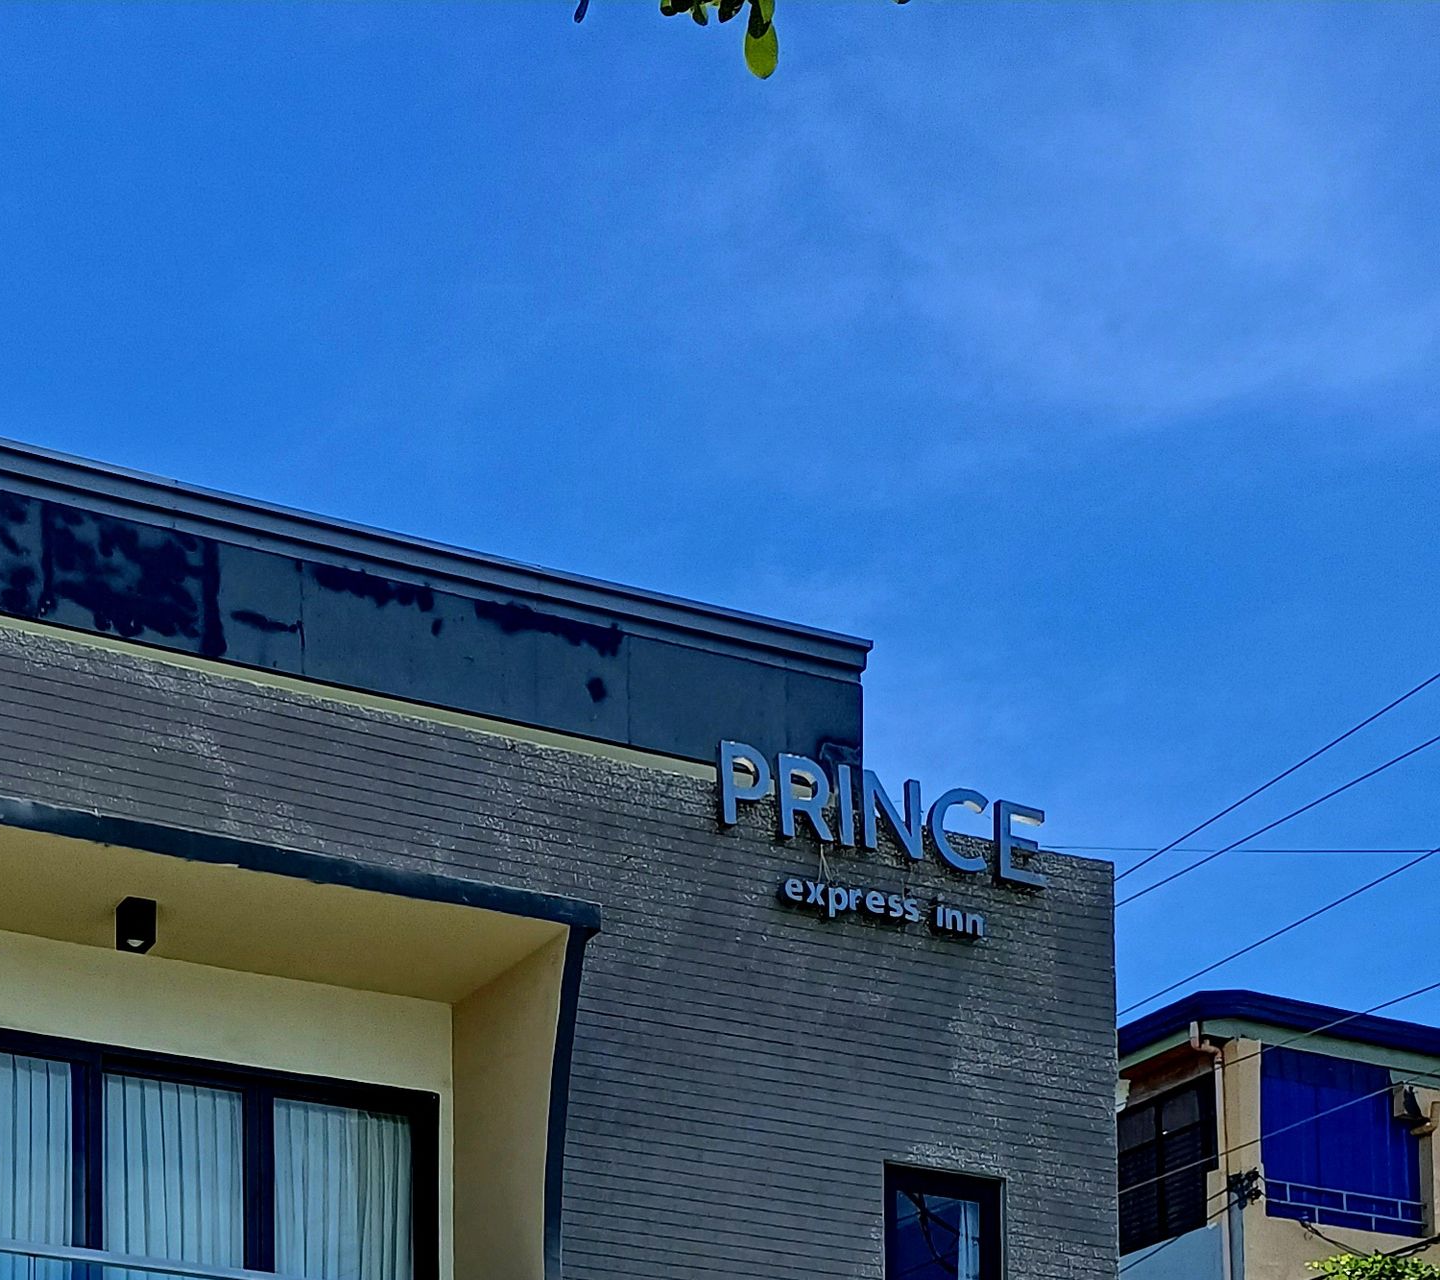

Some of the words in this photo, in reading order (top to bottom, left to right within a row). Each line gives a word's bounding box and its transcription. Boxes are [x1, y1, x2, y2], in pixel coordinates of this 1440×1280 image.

[716, 739, 1047, 891] PRINCE
[784, 876, 920, 922] express
[935, 904, 986, 938] inn
